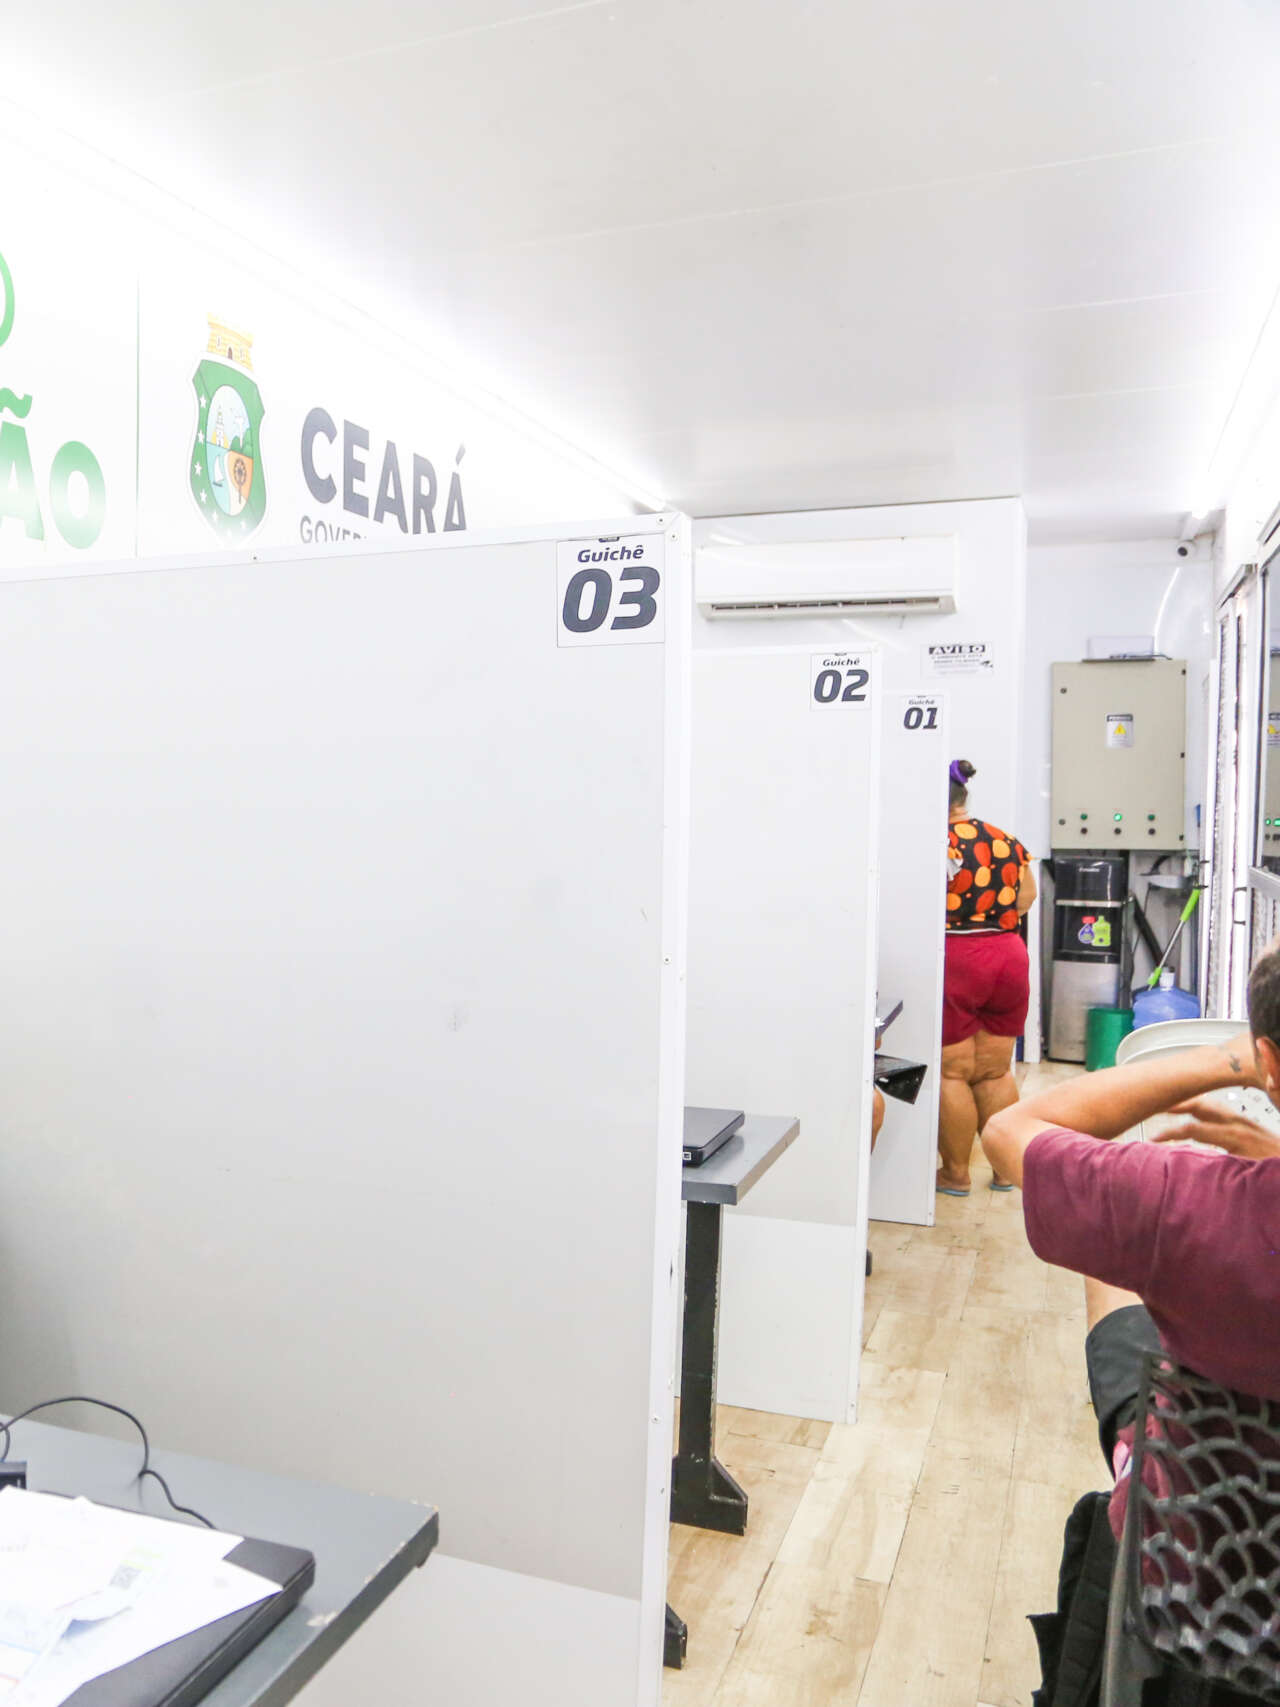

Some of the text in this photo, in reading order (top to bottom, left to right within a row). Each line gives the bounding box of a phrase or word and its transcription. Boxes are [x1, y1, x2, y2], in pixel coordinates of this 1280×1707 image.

[300, 407, 467, 535] CEARÁ
[577, 545, 644, 563] Guichê
[562, 566, 660, 633] 03
[813, 669, 869, 703] 02
[903, 707, 938, 730] 01
